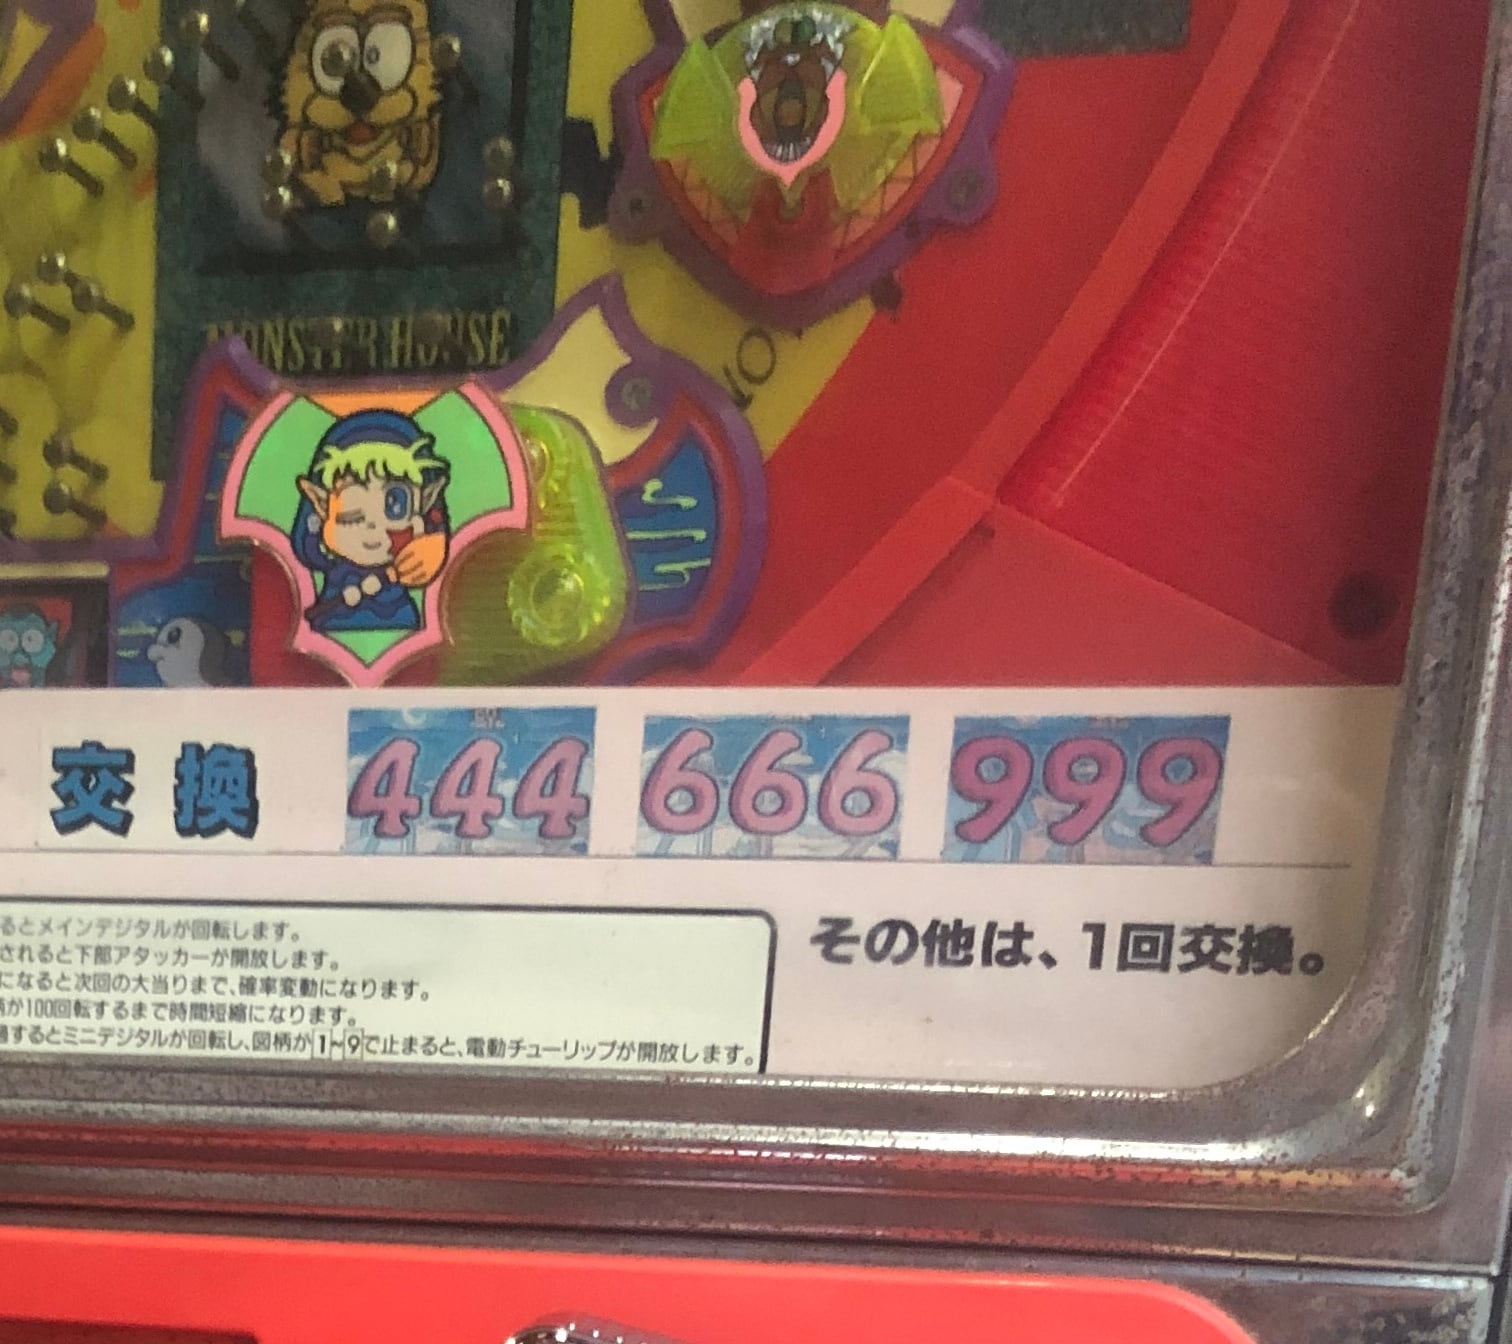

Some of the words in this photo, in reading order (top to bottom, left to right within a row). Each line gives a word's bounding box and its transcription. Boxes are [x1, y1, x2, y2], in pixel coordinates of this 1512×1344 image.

[49, 738, 260, 840] 交換
[347, 735, 592, 839] 444
[641, 727, 898, 837] 666
[950, 733, 1225, 848] 999
